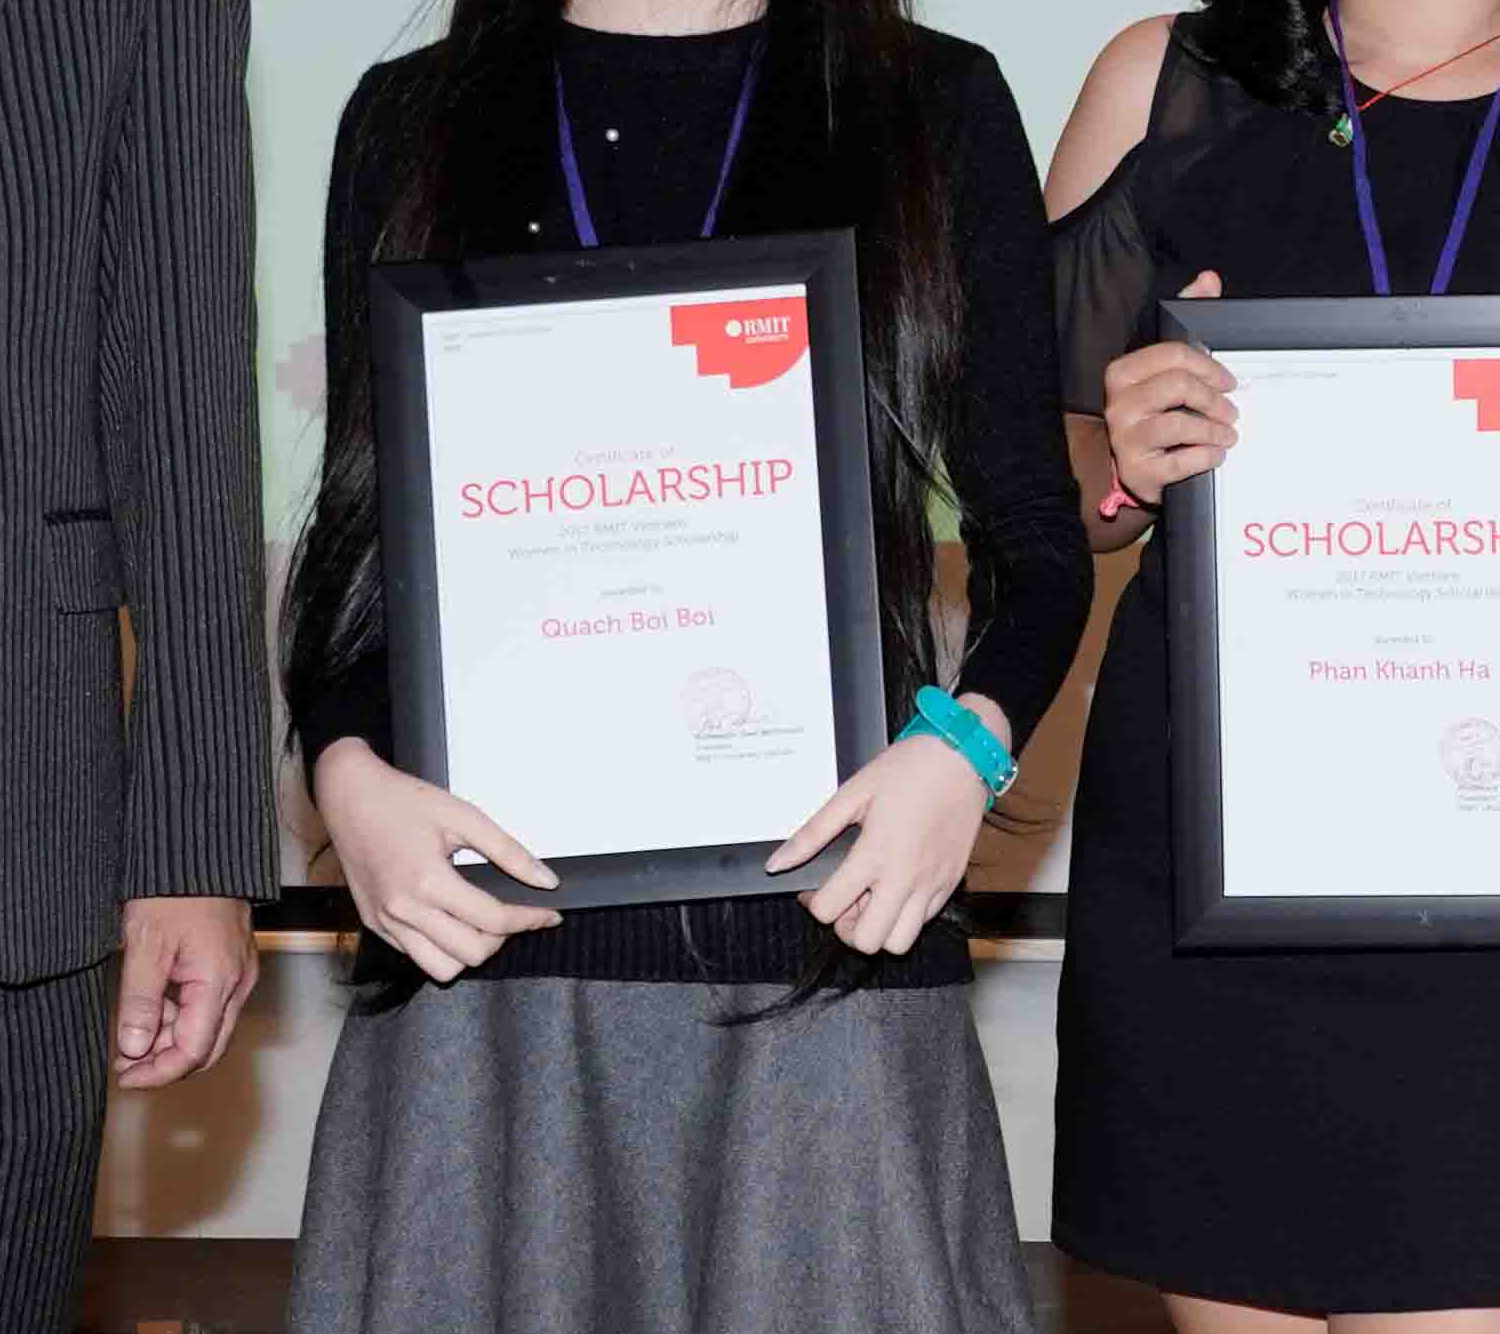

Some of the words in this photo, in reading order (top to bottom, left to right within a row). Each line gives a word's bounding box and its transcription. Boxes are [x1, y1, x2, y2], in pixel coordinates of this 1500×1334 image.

[744, 315, 790, 335] RMIT
[460, 459, 793, 518] SCHOLARSHIP
[541, 612, 622, 637] Quach
[1308, 660, 1367, 683] Phan
[1376, 659, 1451, 682] Khanh
[1458, 659, 1492, 681] Ha
